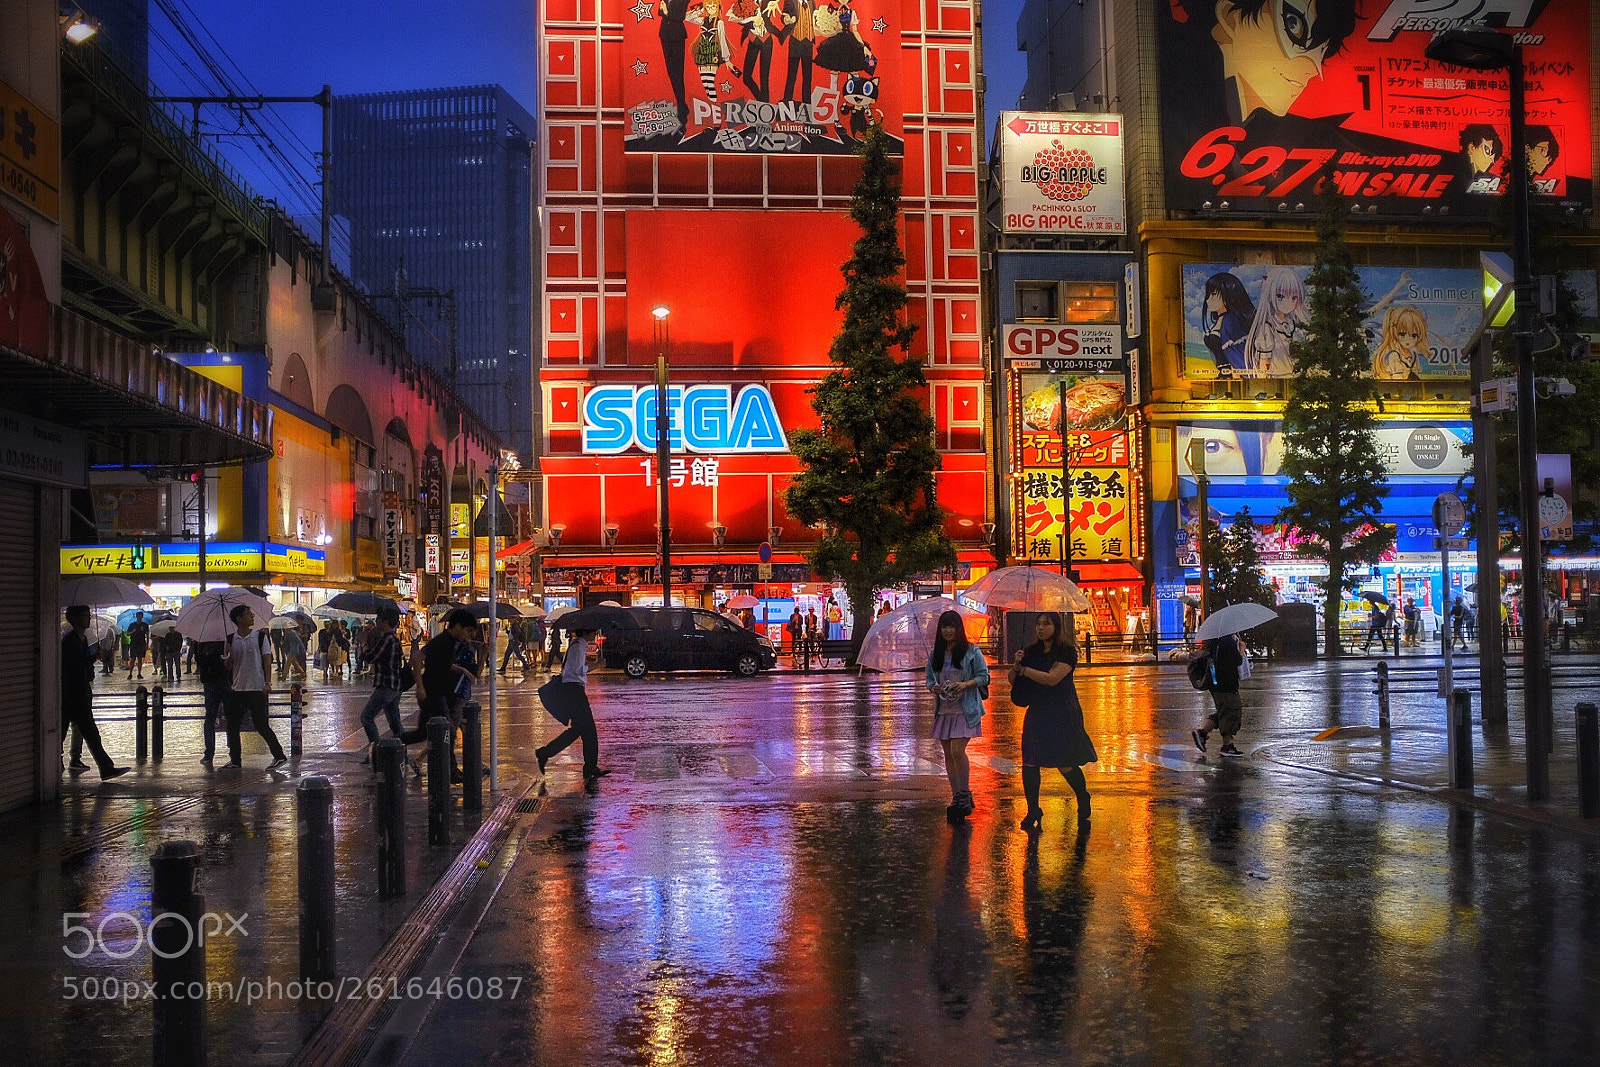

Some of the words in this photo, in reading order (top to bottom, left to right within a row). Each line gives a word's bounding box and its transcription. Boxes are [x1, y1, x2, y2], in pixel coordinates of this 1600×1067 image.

[1357, 75, 1371, 111] 1
[1388, 77, 1545, 92] チケット最速優先販売申込封入
[773, 123, 822, 134] Animation
[1025, 121, 1109, 134] 万世橋すぐよこ!
[722, 130, 802, 151] キャンペーン
[1180, 126, 1337, 197] 6.27
[1021, 166, 1052, 182] BIG
[1058, 166, 1107, 184] APPLE
[1363, 172, 1454, 198] SALE
[1032, 204, 1072, 212] PACHINKO
[1007, 213, 1036, 228] BIG
[1086, 222, 1122, 230] 秋葉原店
[1409, 283, 1477, 300] Summer
[1008, 328, 1080, 355] GPS
[1082, 344, 1113, 355] next
[1053, 360, 1113, 369] 0120-915-047
[583, 383, 791, 455] SEGA
[640, 458, 720, 487] 1号館
[1024, 500, 1126, 537] ラーメン
[428, 547, 438, 572] お弁当
